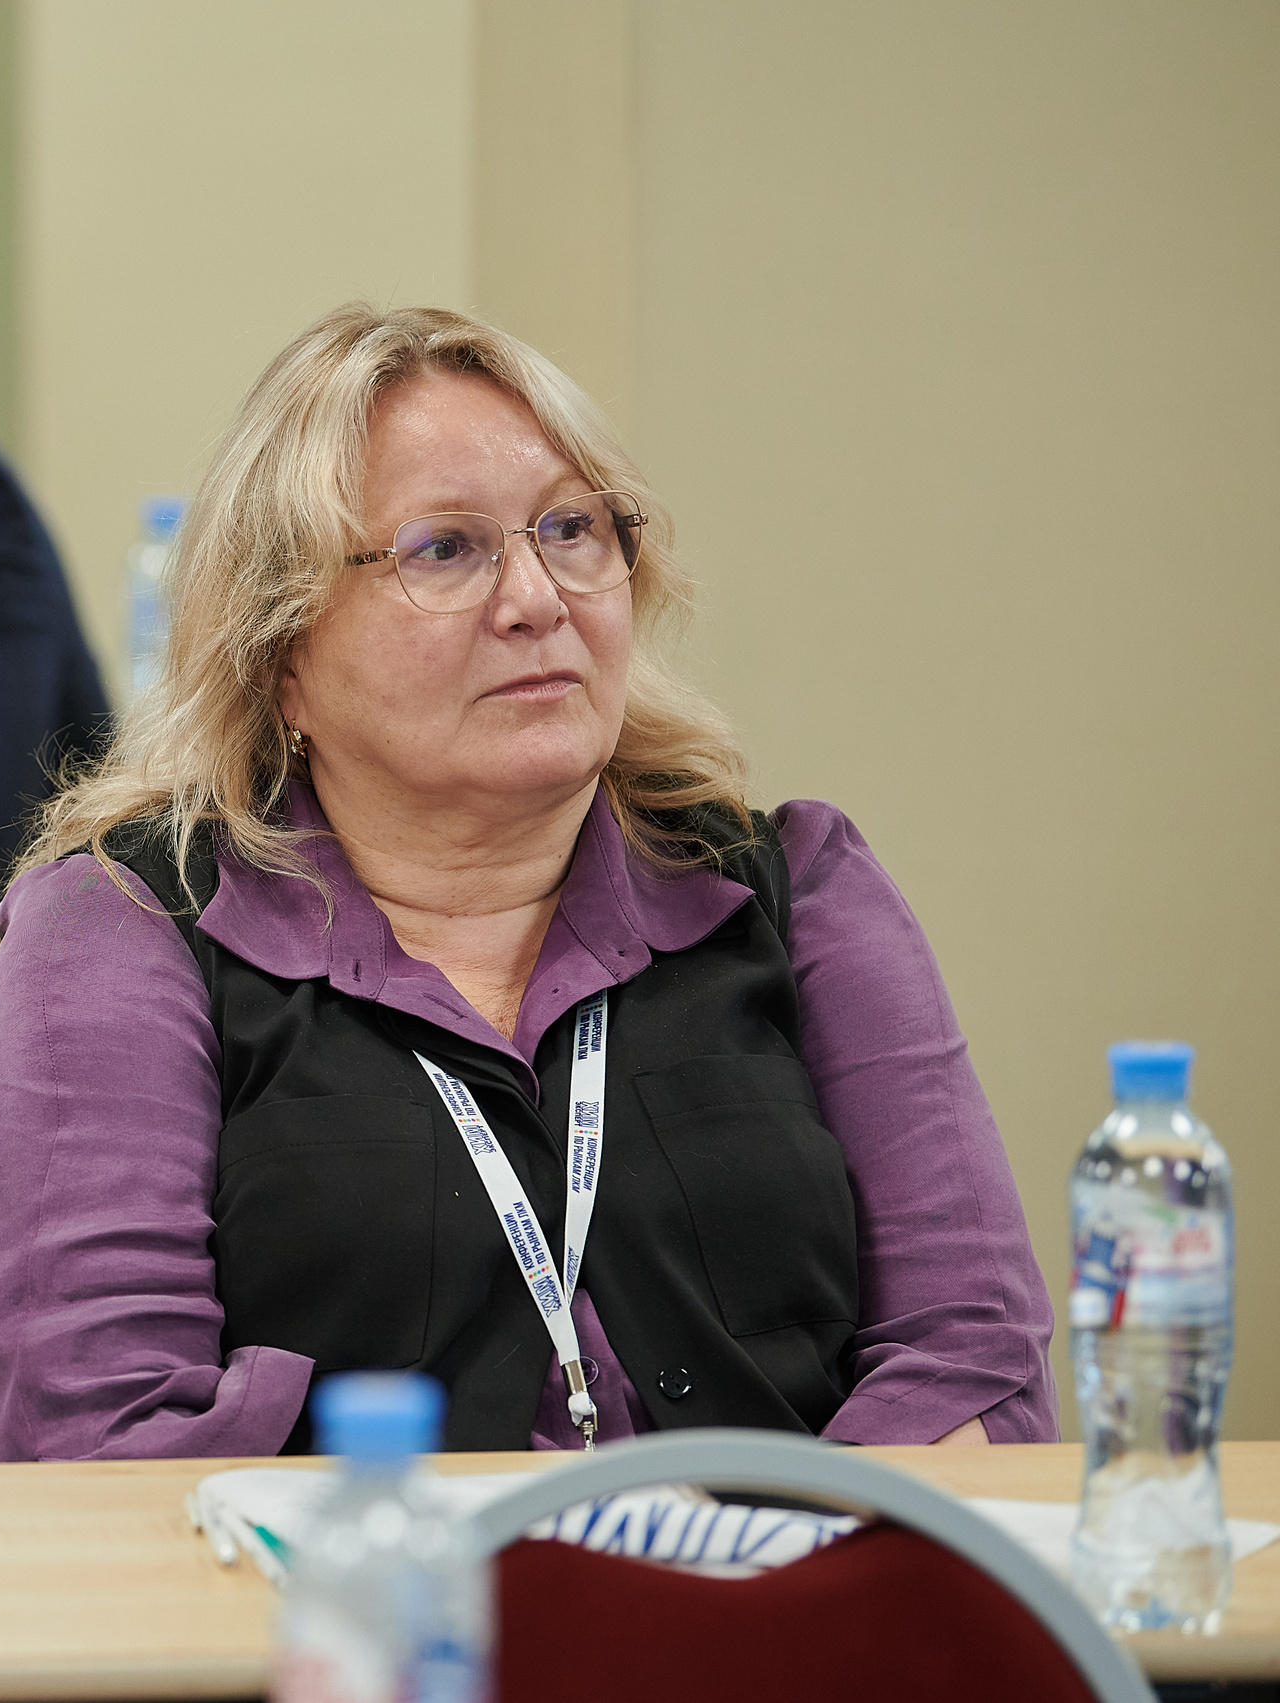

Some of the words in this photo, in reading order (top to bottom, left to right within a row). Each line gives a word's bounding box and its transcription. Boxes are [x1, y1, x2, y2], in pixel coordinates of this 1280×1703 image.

[581, 1101, 599, 1128] ХИМ
[462, 1125, 492, 1155] ХИМ
[574, 1135, 584, 1144] ПО
[572, 1145, 584, 1175] РЫНКАМ
[583, 1137, 597, 1191] КОНФЕРЕНЦИИ
[512, 1201, 529, 1218] ЛКМ
[503, 1212, 535, 1271] КОНФЕРЕНЦИИ
[521, 1218, 541, 1252] РЫНКАМ
[535, 1252, 547, 1264] ПО
[532, 1276, 560, 1318] ХИМ
